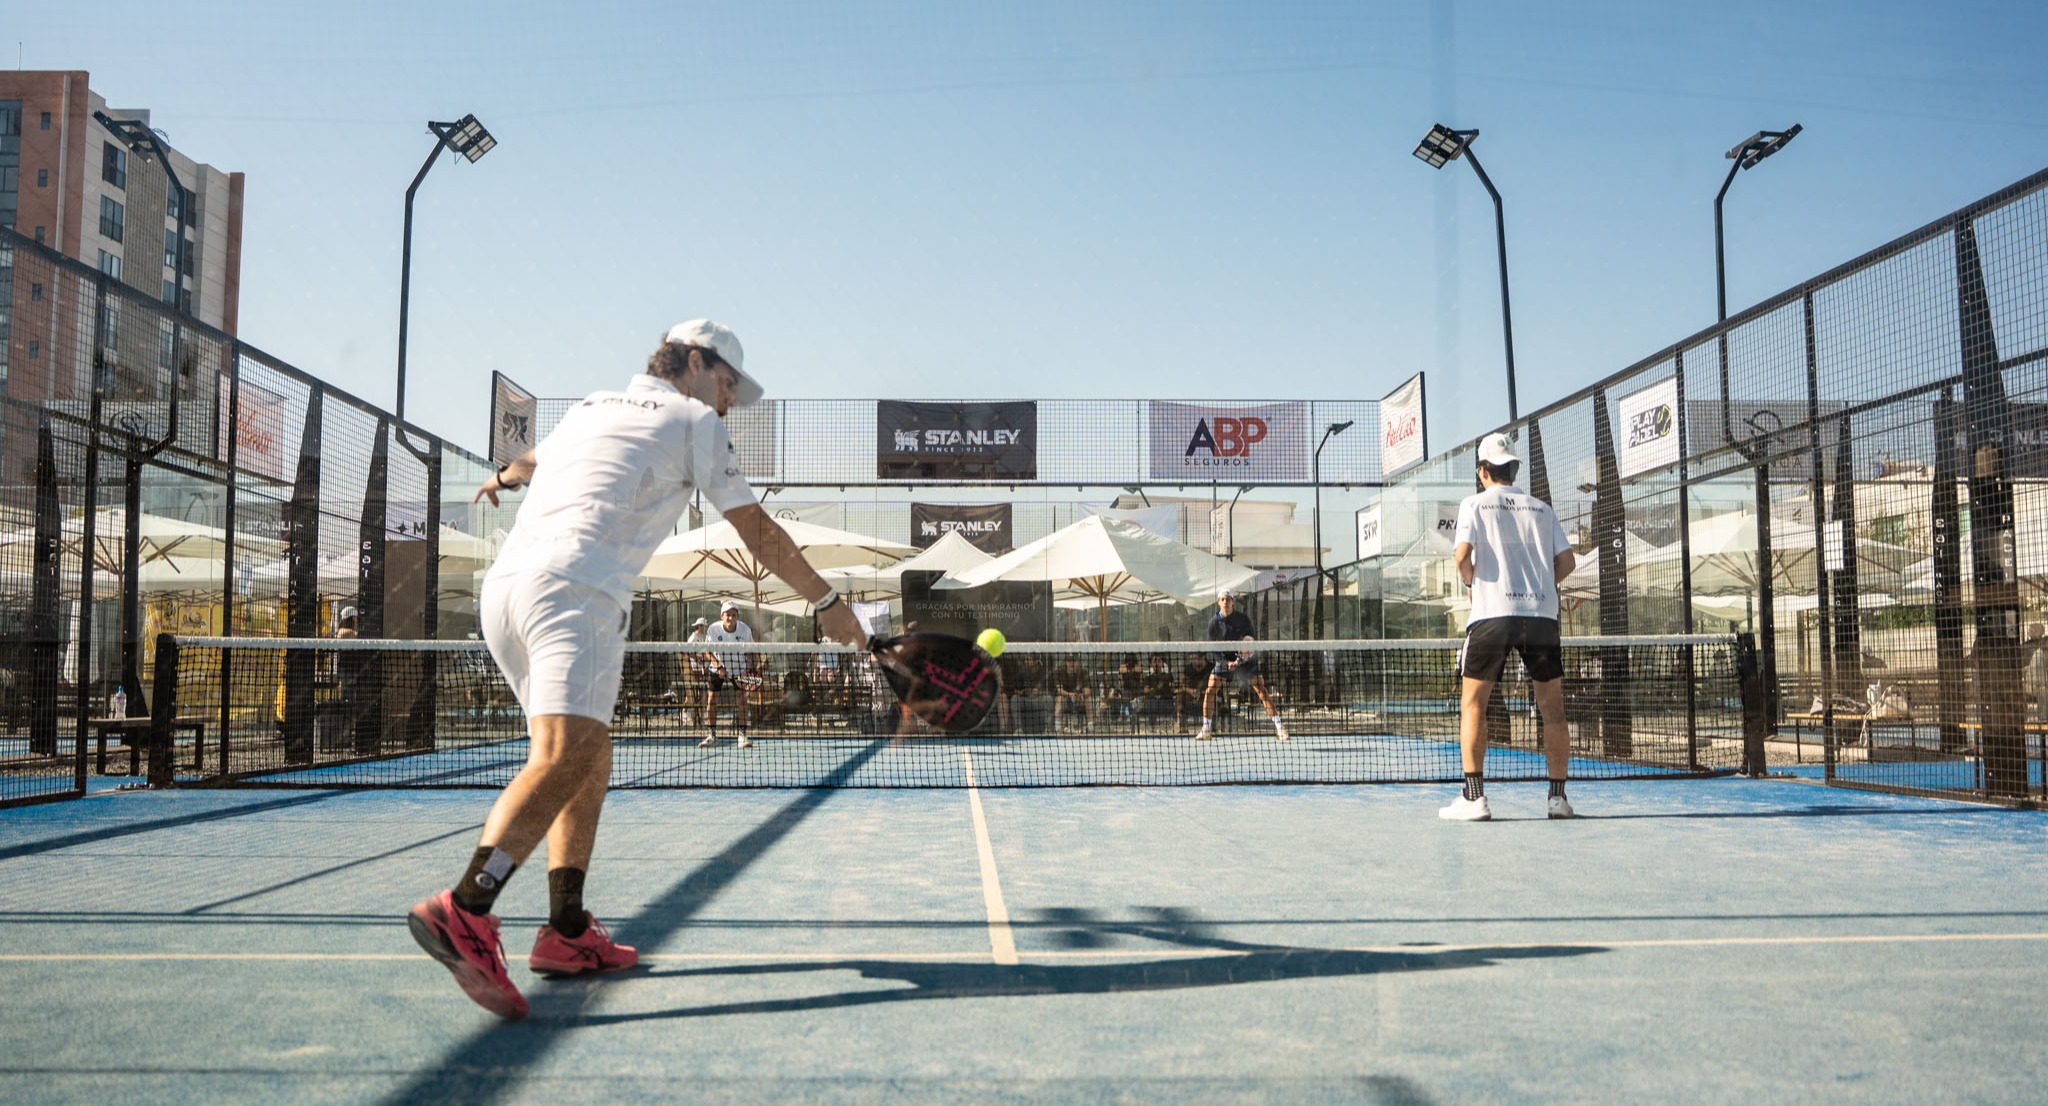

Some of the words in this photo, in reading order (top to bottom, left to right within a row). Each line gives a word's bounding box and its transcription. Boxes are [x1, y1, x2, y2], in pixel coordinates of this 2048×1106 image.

[601, 397, 665, 410] STLEY
[925, 429, 1021, 445] STANLEY
[1185, 417, 1267, 457] ABP
[1184, 458, 1249, 466] SEGUROS
[940, 521, 1002, 531] STANLEY
[977, 602, 1036, 610] INSPIRARNOS
[931, 611, 950, 619] CON
[953, 611, 964, 619] TU
[968, 611, 1020, 619] TESTIMONIO
